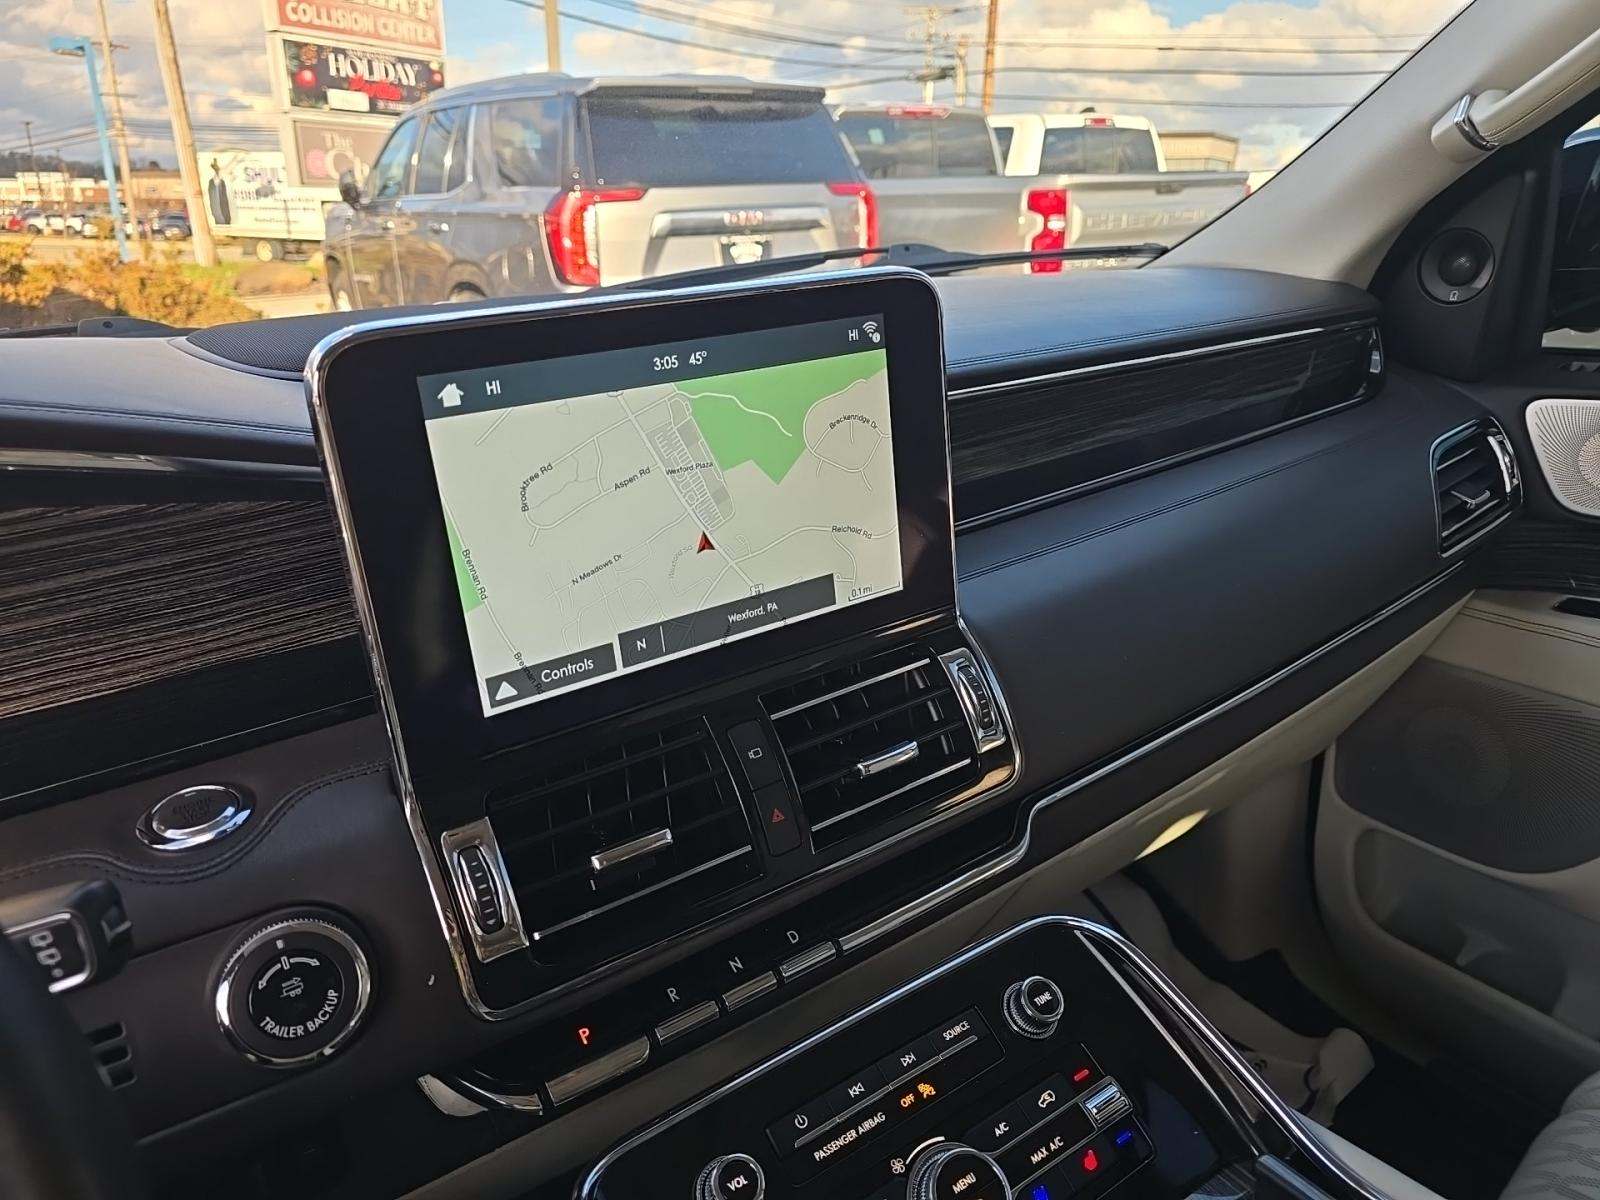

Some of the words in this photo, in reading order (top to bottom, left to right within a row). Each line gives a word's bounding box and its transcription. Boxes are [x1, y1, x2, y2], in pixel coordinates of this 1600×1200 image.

[285, 1, 374, 34] COLLISION
[376, 17, 437, 43] CENTER
[327, 52, 418, 87] HOLIDAY
[320, 132, 353, 150] The
[848, 328, 859, 342] HI
[653, 354, 679, 371] 3:05
[689, 350, 707, 365] 45°
[485, 379, 501, 396] HI
[870, 420, 878, 430] Dr
[695, 461, 714, 470] Plaza
[519, 472, 540, 512] Brooktree
[540, 462, 554, 475] Rd
[614, 472, 639, 492] Aspen
[639, 466, 651, 477] Rd
[831, 525, 862, 535] Reichold
[862, 531, 873, 540] Rd
[461, 548, 481, 587] Brennan
[477, 586, 489, 601] Rd
[571, 577, 579, 585] N
[579, 558, 614, 581] Meadows
[613, 553, 623, 562] Dr
[851, 587, 861, 598] 0.1
[863, 584, 873, 594] mi
[727, 605, 766, 624] Wexford,
[767, 602, 779, 613] PA
[636, 638, 647, 651] N
[541, 657, 594, 683] Controls
[786, 930, 799, 944] D
[728, 956, 743, 973] N
[667, 987, 681, 1002] R
[1033, 991, 1052, 1008] TUNE
[259, 1016, 305, 1038] TRAILER
[306, 989, 339, 1032] BACKUP
[578, 1027, 590, 1045] P
[942, 1020, 970, 1041] SOURCE
[900, 1092, 916, 1109] OFF
[814, 1128, 857, 1162] PASSENGER
[857, 1112, 886, 1142] AIRBAG
[994, 1121, 1009, 1137] A/C
[1030, 1147, 1050, 1165] MAX
[1048, 1135, 1064, 1152] A/C
[727, 1174, 748, 1193] VOL
[952, 1171, 977, 1195] MENU
